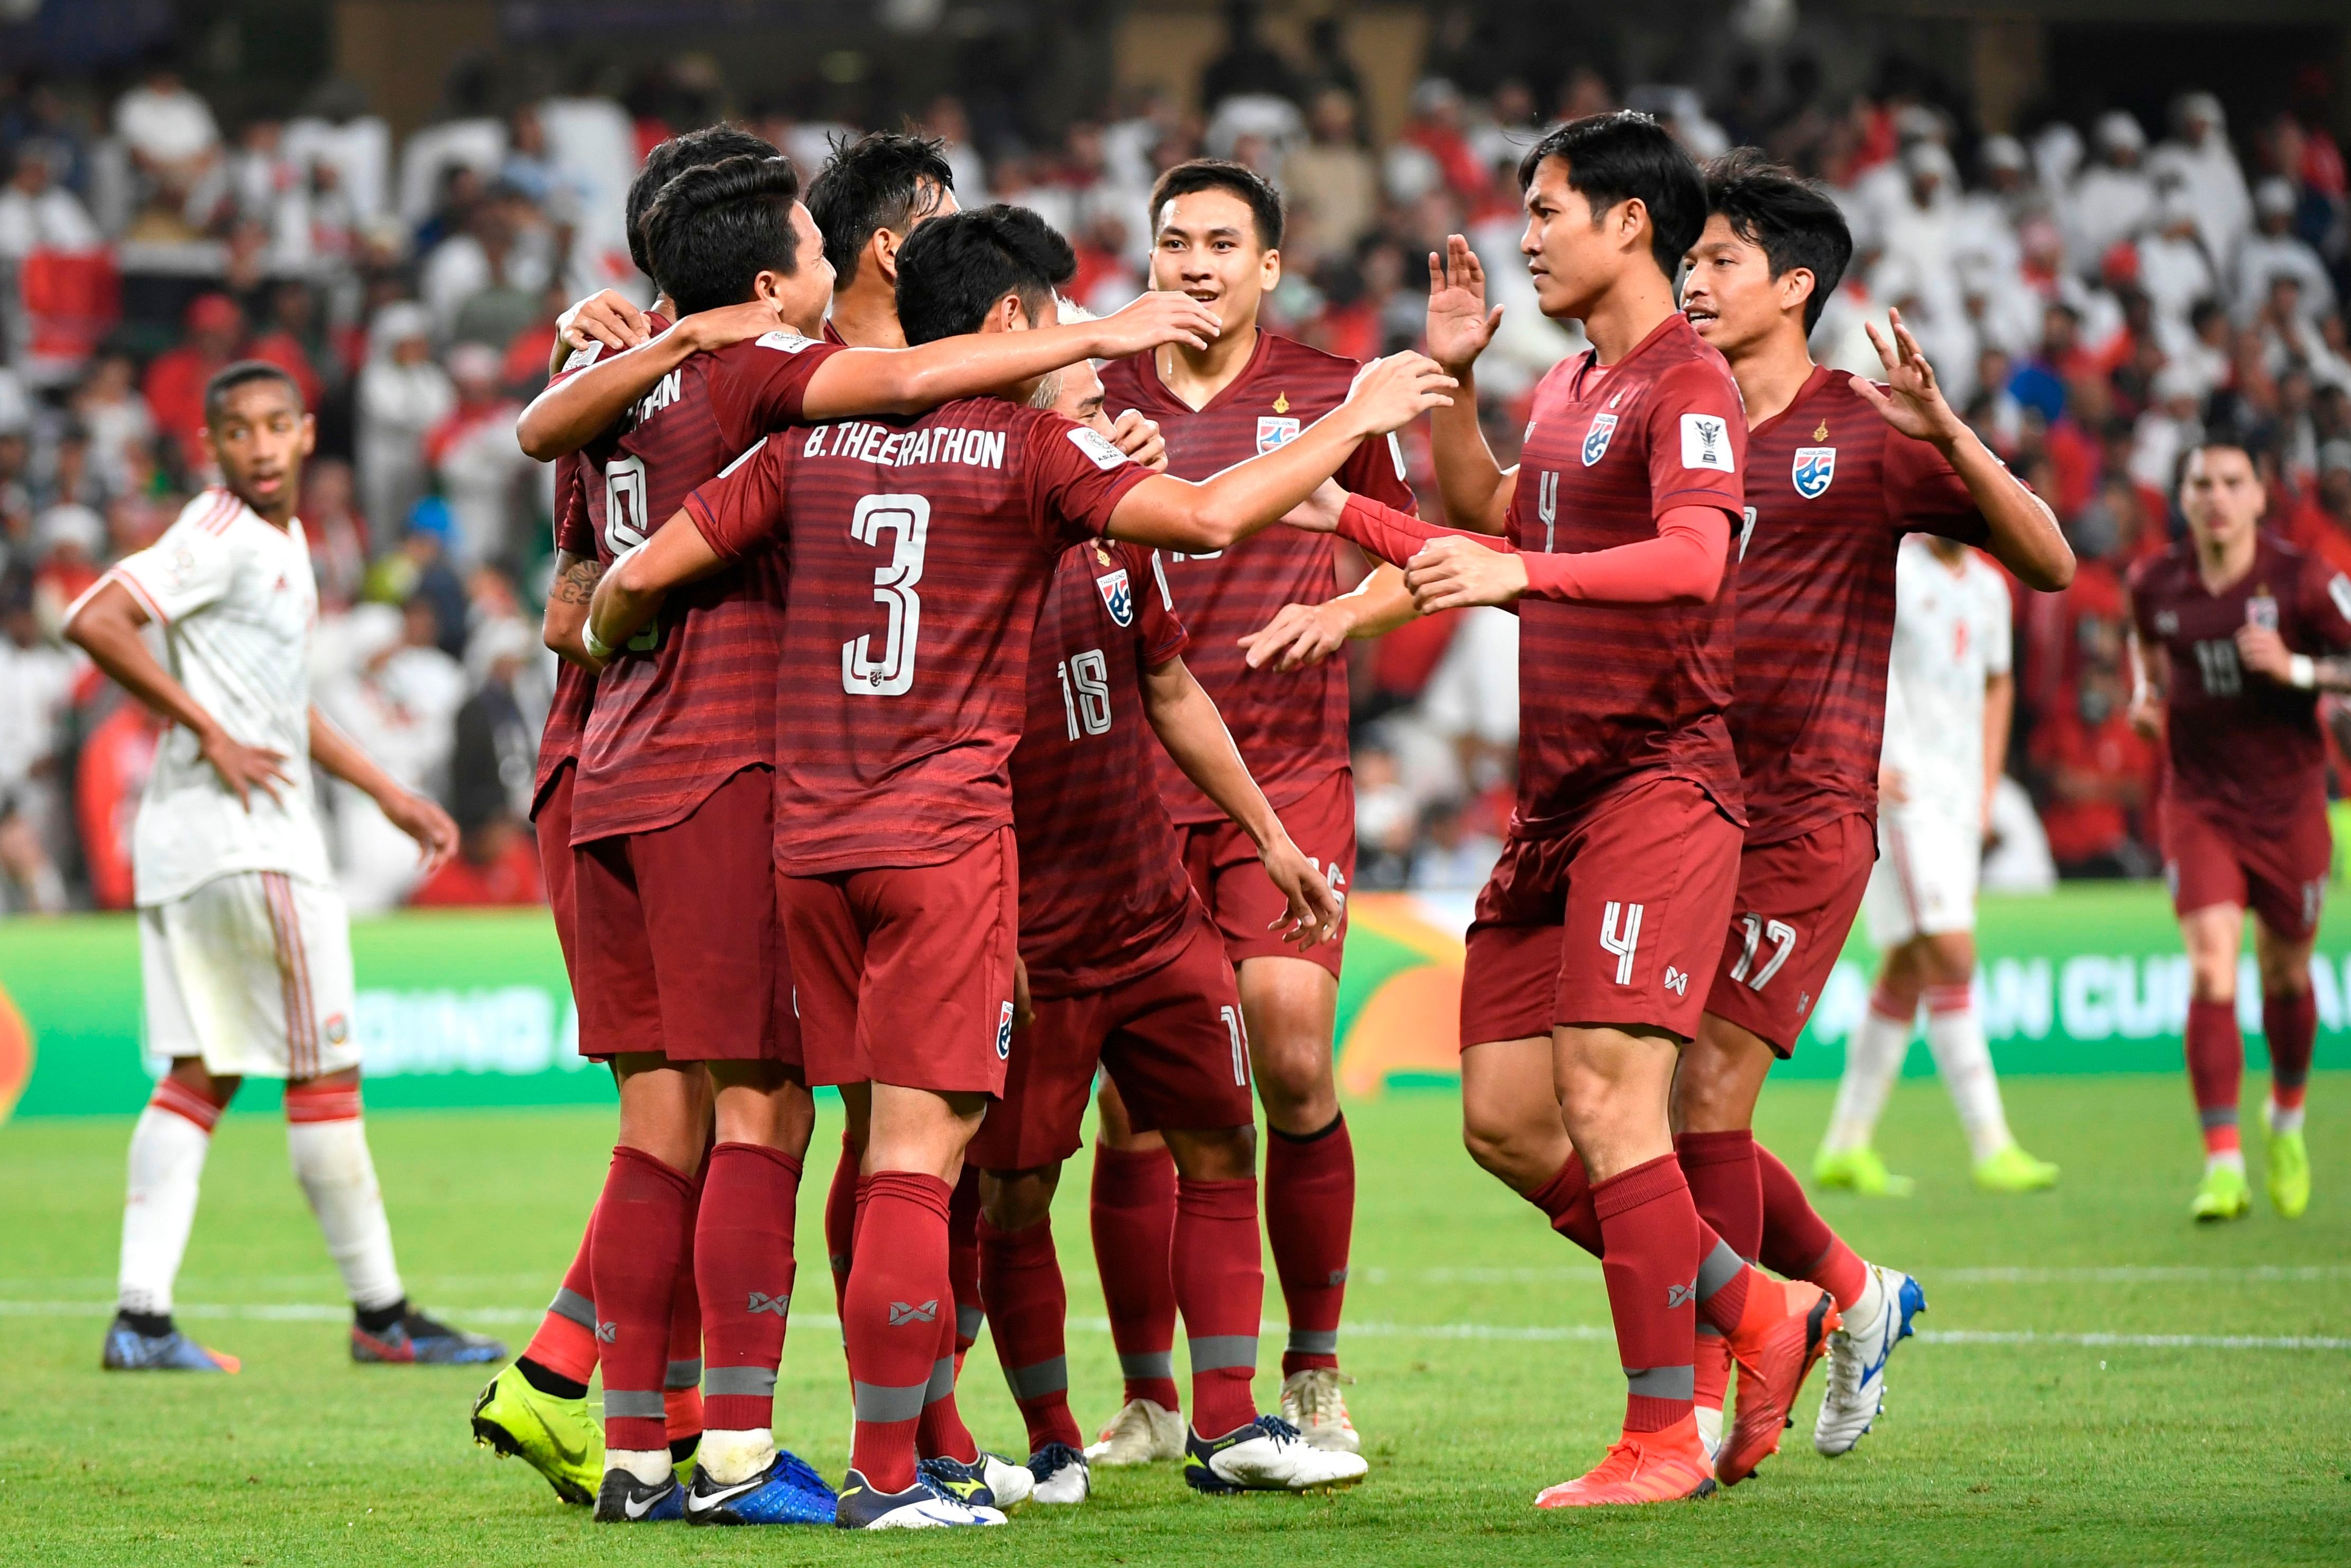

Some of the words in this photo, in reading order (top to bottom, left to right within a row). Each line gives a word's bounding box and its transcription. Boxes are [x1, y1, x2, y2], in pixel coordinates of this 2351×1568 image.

[803, 421, 1006, 470] B.THEERATHON
[1538, 470, 1559, 553] 4
[842, 493, 931, 696] 3
[1057, 648, 1112, 742] 18
[1600, 901, 1644, 985] 4
[1730, 911, 1796, 992] 17
